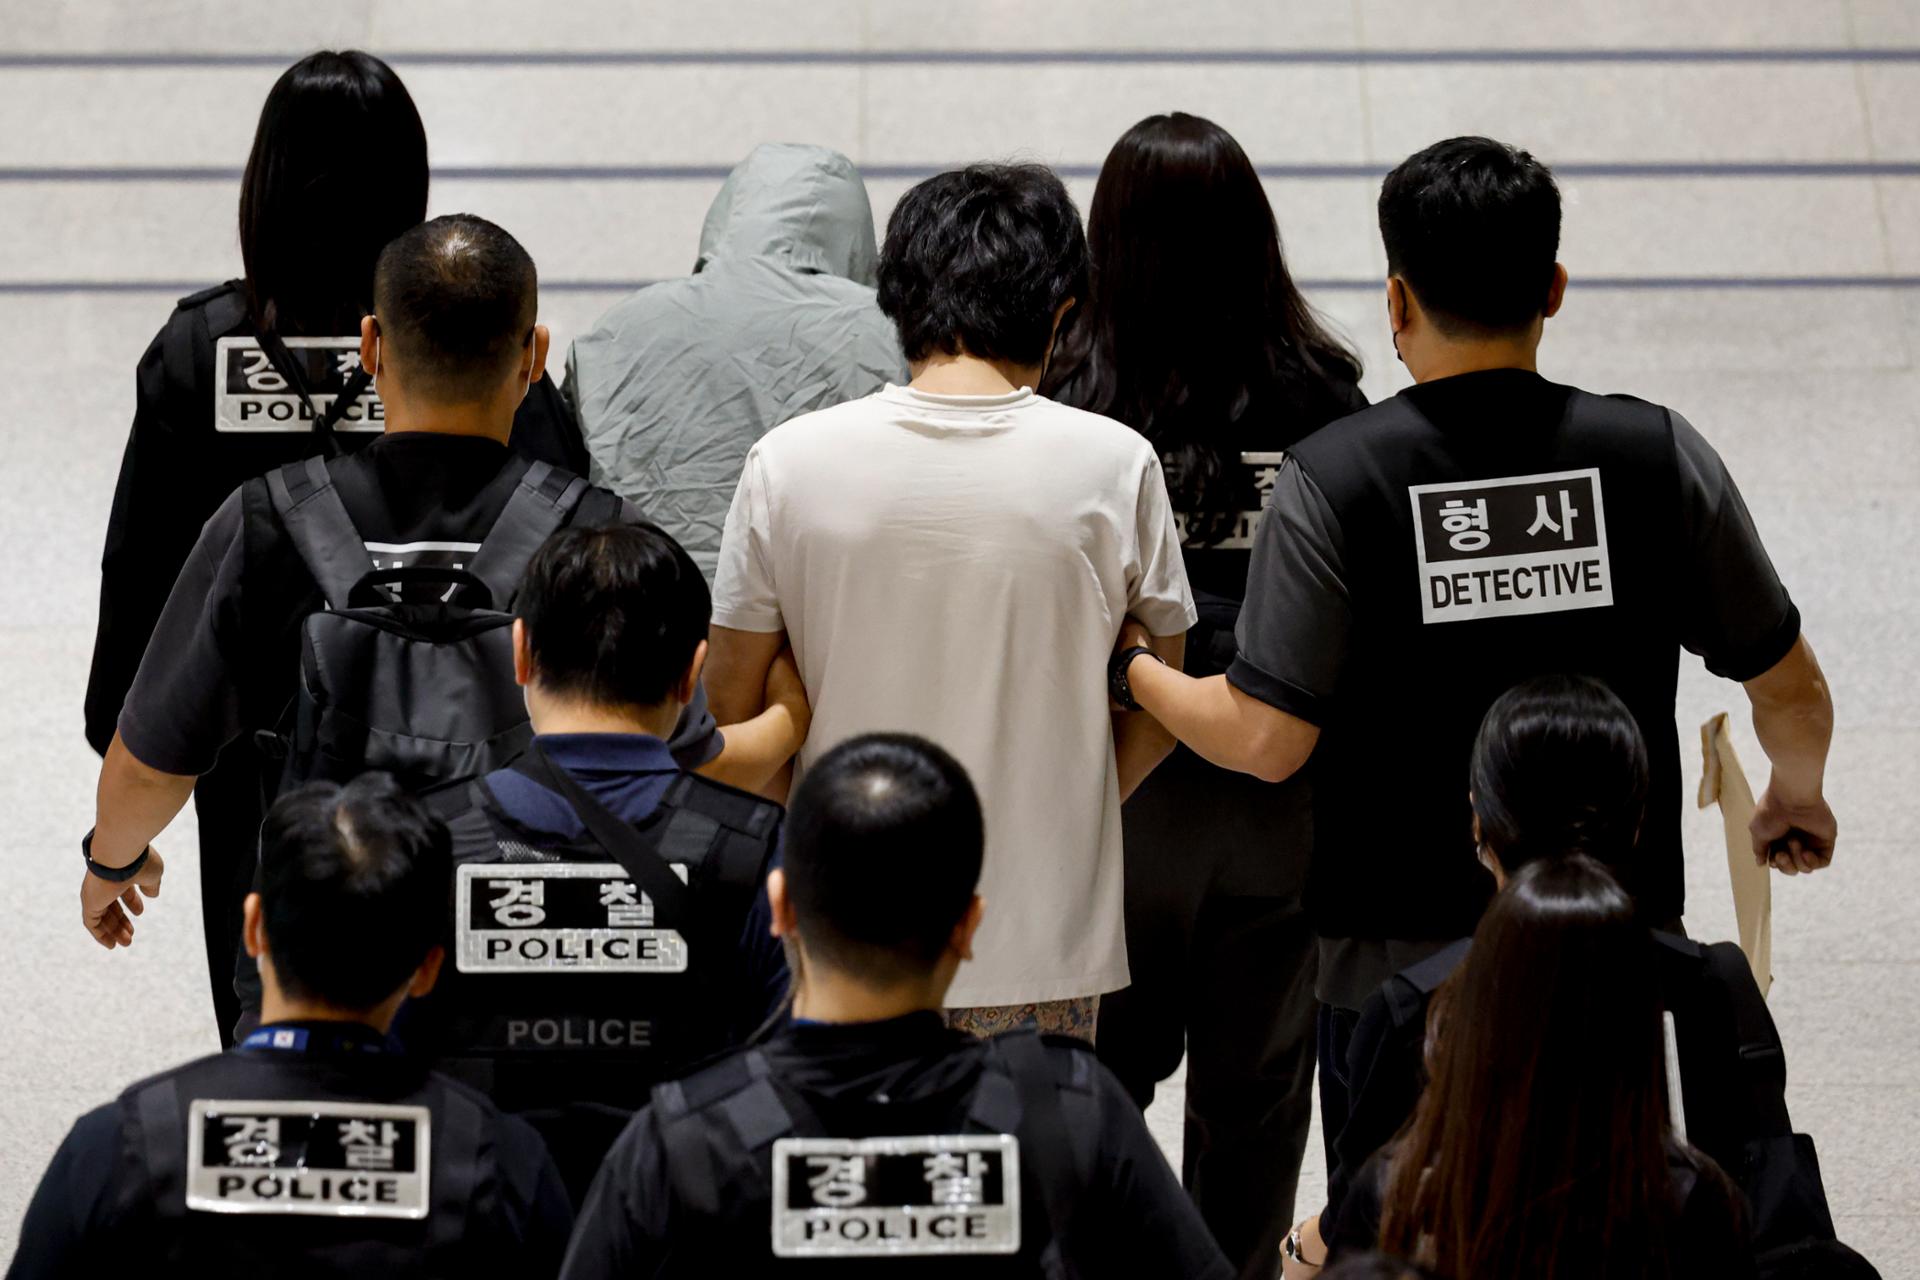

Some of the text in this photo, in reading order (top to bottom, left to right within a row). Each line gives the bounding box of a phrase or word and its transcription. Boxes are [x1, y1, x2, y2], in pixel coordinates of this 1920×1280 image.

[1430, 560, 1602, 608] DETECTIVE
[487, 938, 658, 960] POLICE
[507, 1019, 651, 1045] POLICE
[218, 1176, 397, 1201] POLICE
[804, 1214, 987, 1241] POLICE
